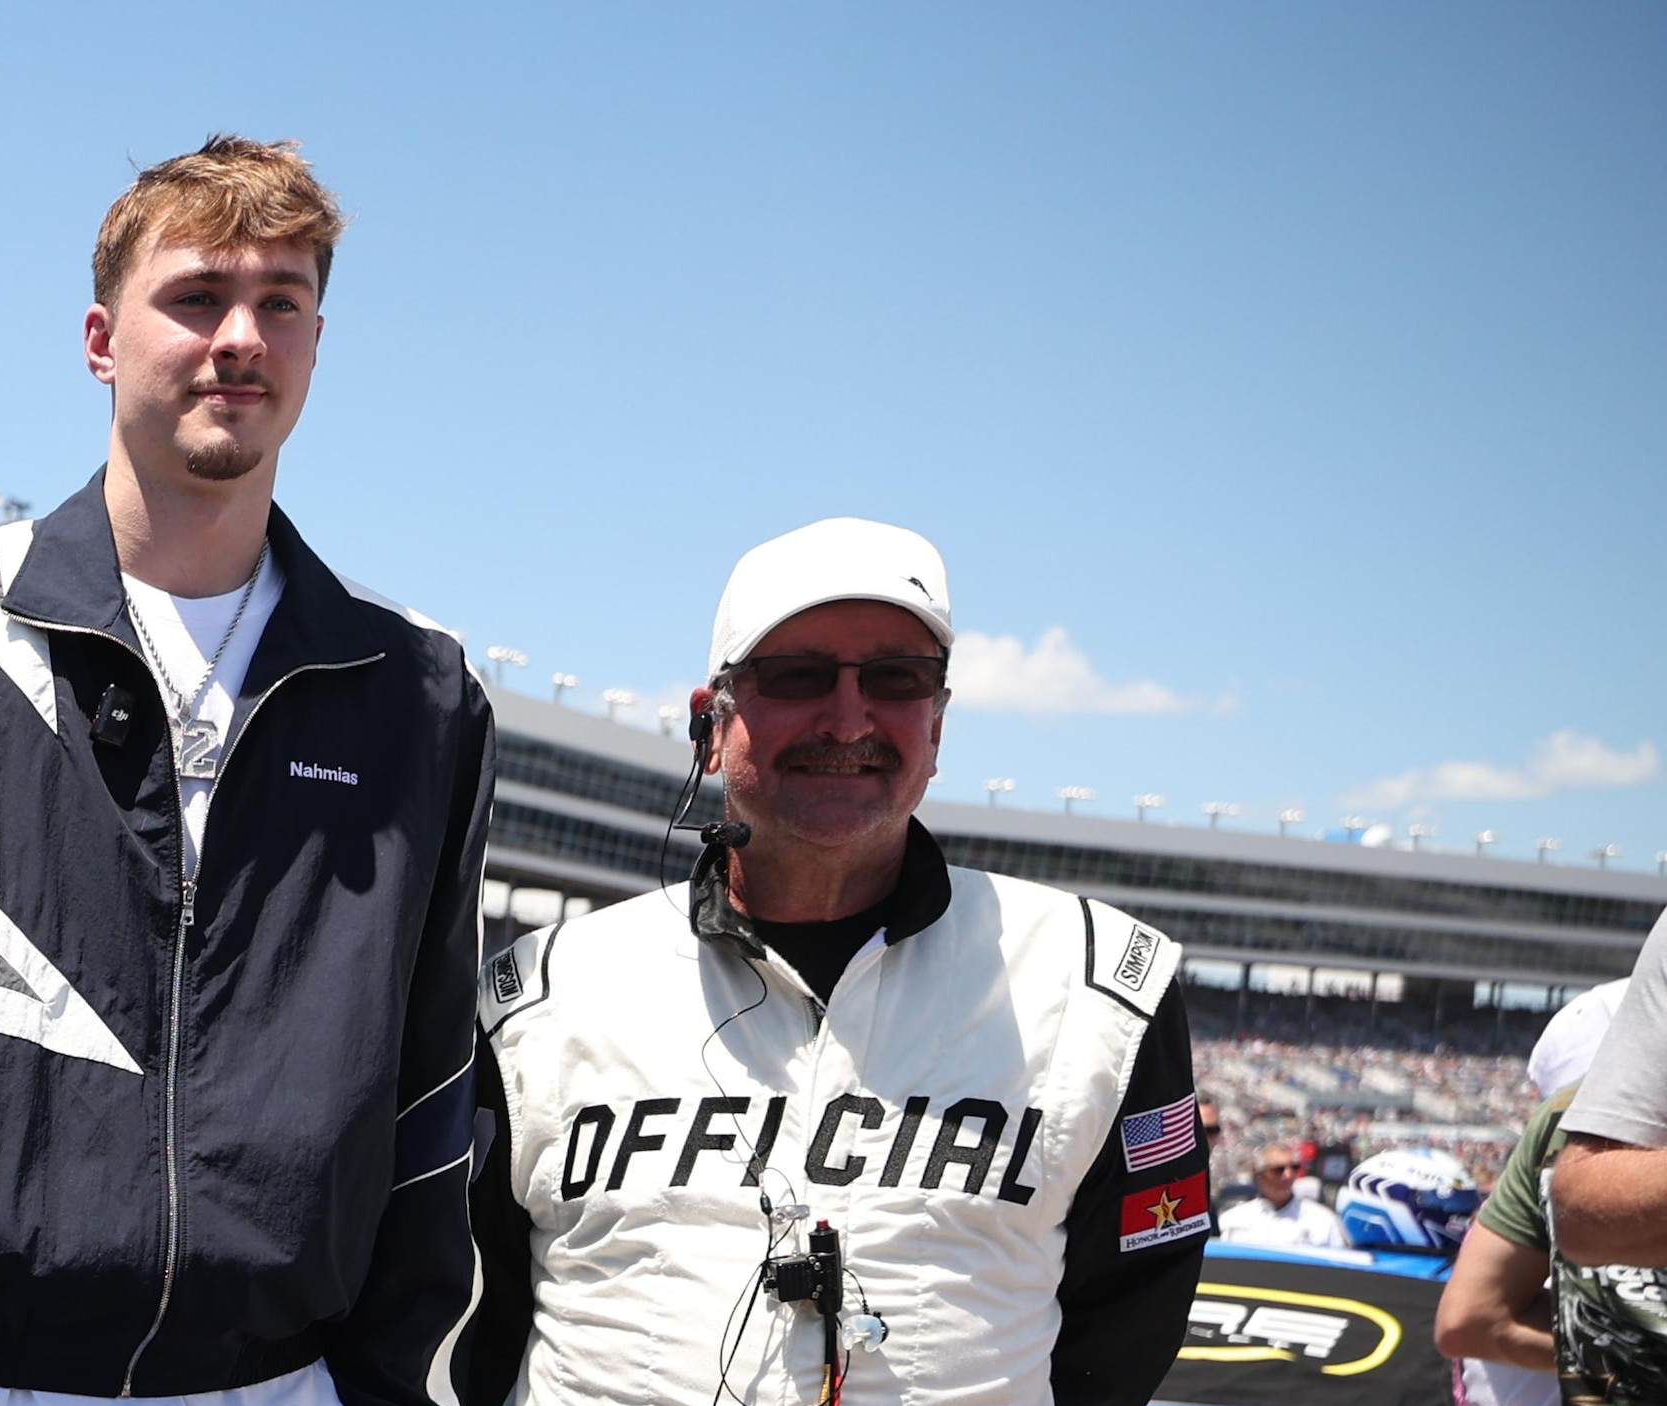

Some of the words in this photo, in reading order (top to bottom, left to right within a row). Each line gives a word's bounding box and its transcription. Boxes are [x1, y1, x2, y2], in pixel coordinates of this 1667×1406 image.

[290, 761, 359, 785] Nahmias
[1120, 930, 1154, 984] SIMPSON
[561, 1092, 1043, 1206] OFFICIAL
